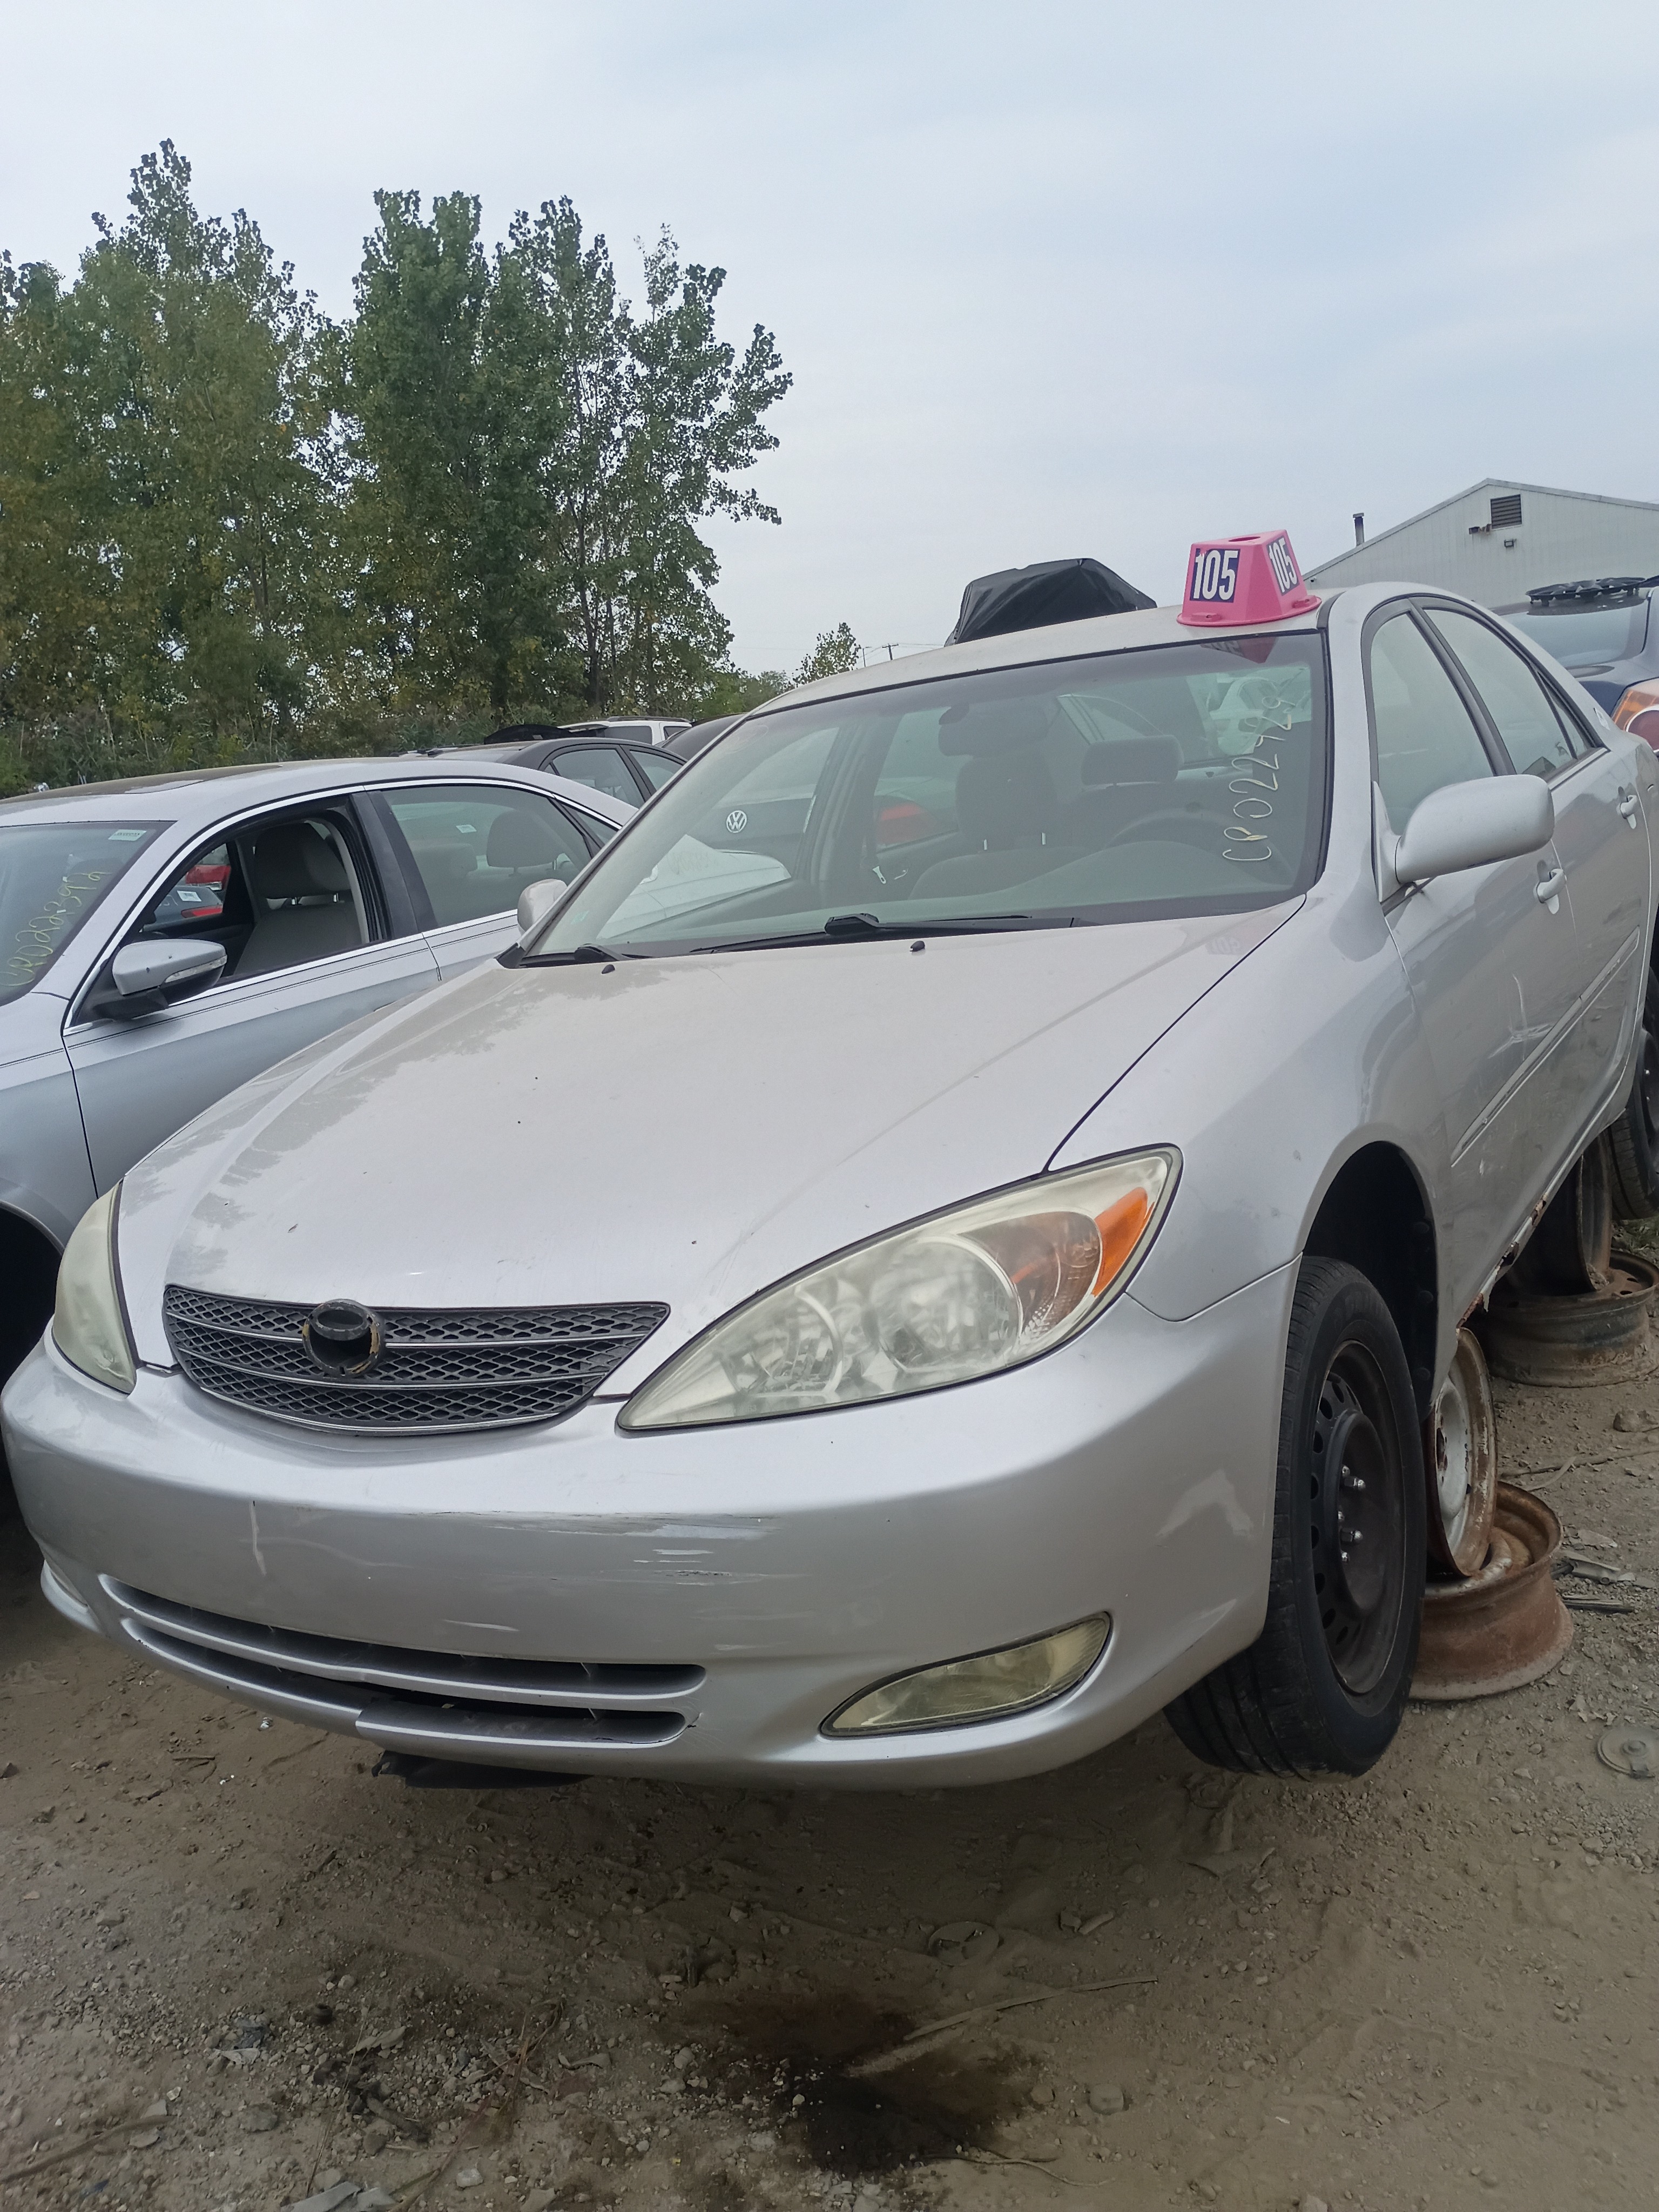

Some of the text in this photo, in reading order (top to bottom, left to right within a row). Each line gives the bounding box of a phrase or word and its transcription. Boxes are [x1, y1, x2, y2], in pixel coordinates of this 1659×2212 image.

[1193, 549, 1239, 601] 105
[1269, 537, 1298, 593] 105
[726, 810, 747, 833] VW
